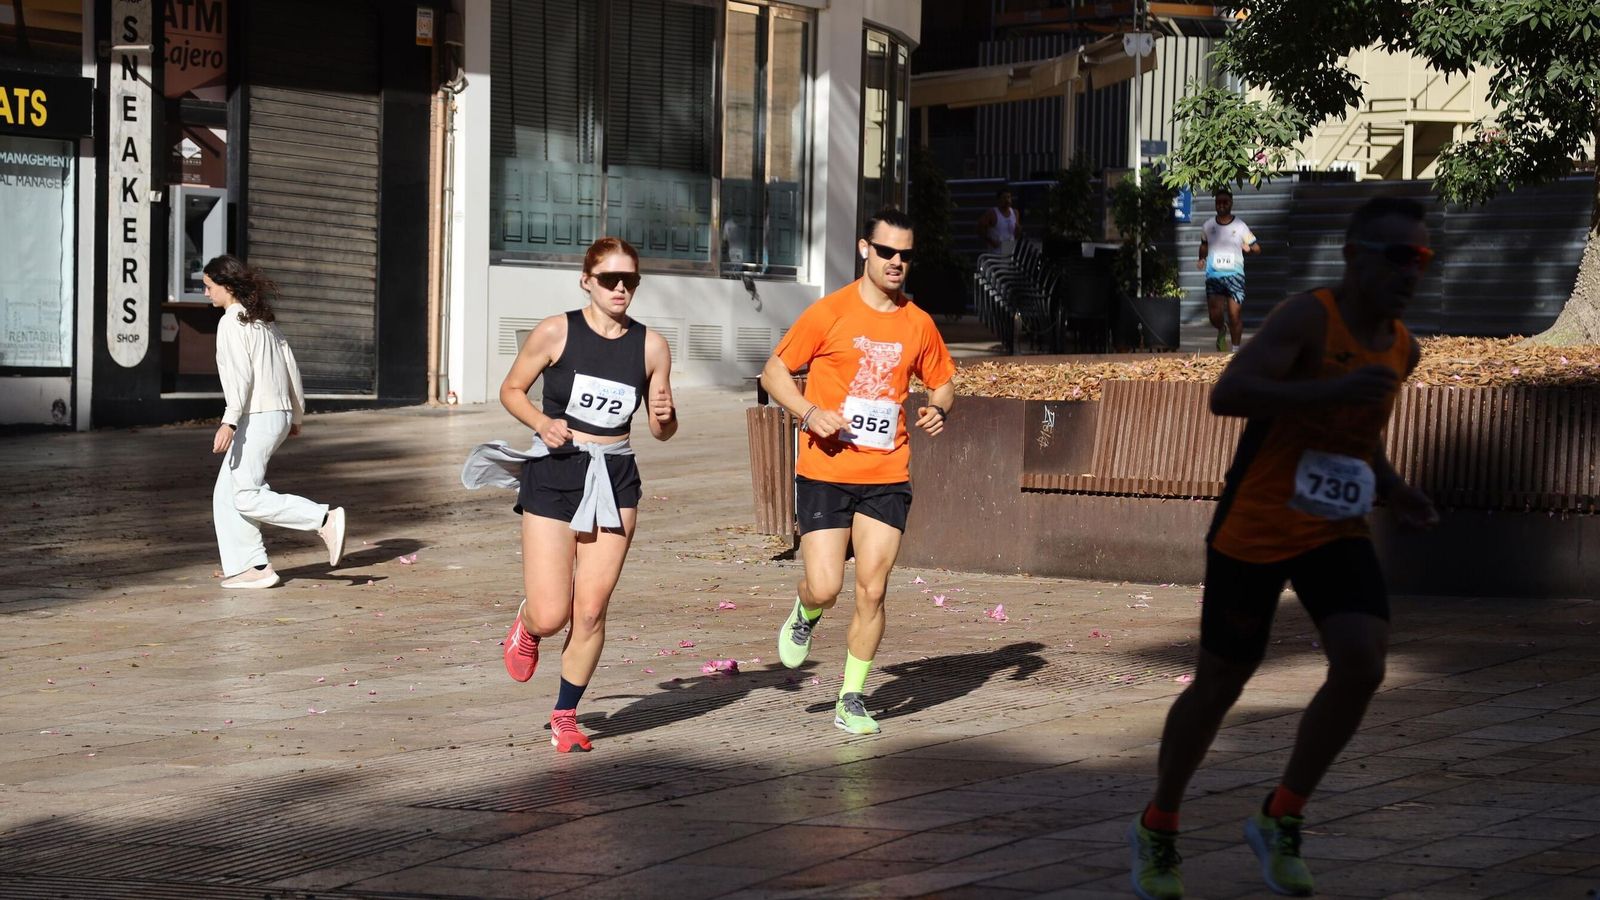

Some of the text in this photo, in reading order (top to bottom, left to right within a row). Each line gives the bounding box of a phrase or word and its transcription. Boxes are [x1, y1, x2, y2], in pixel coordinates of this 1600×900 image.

[163, 0, 222, 33] ATM
[0, 86, 48, 127] ATS
[0, 152, 70, 168] MANAGEMENT
[122, 16, 139, 324] SNEAKERS
[116, 334, 140, 343] SHOP
[579, 393, 623, 415] 972
[851, 415, 890, 434] 952
[1307, 473, 1361, 504] 730
